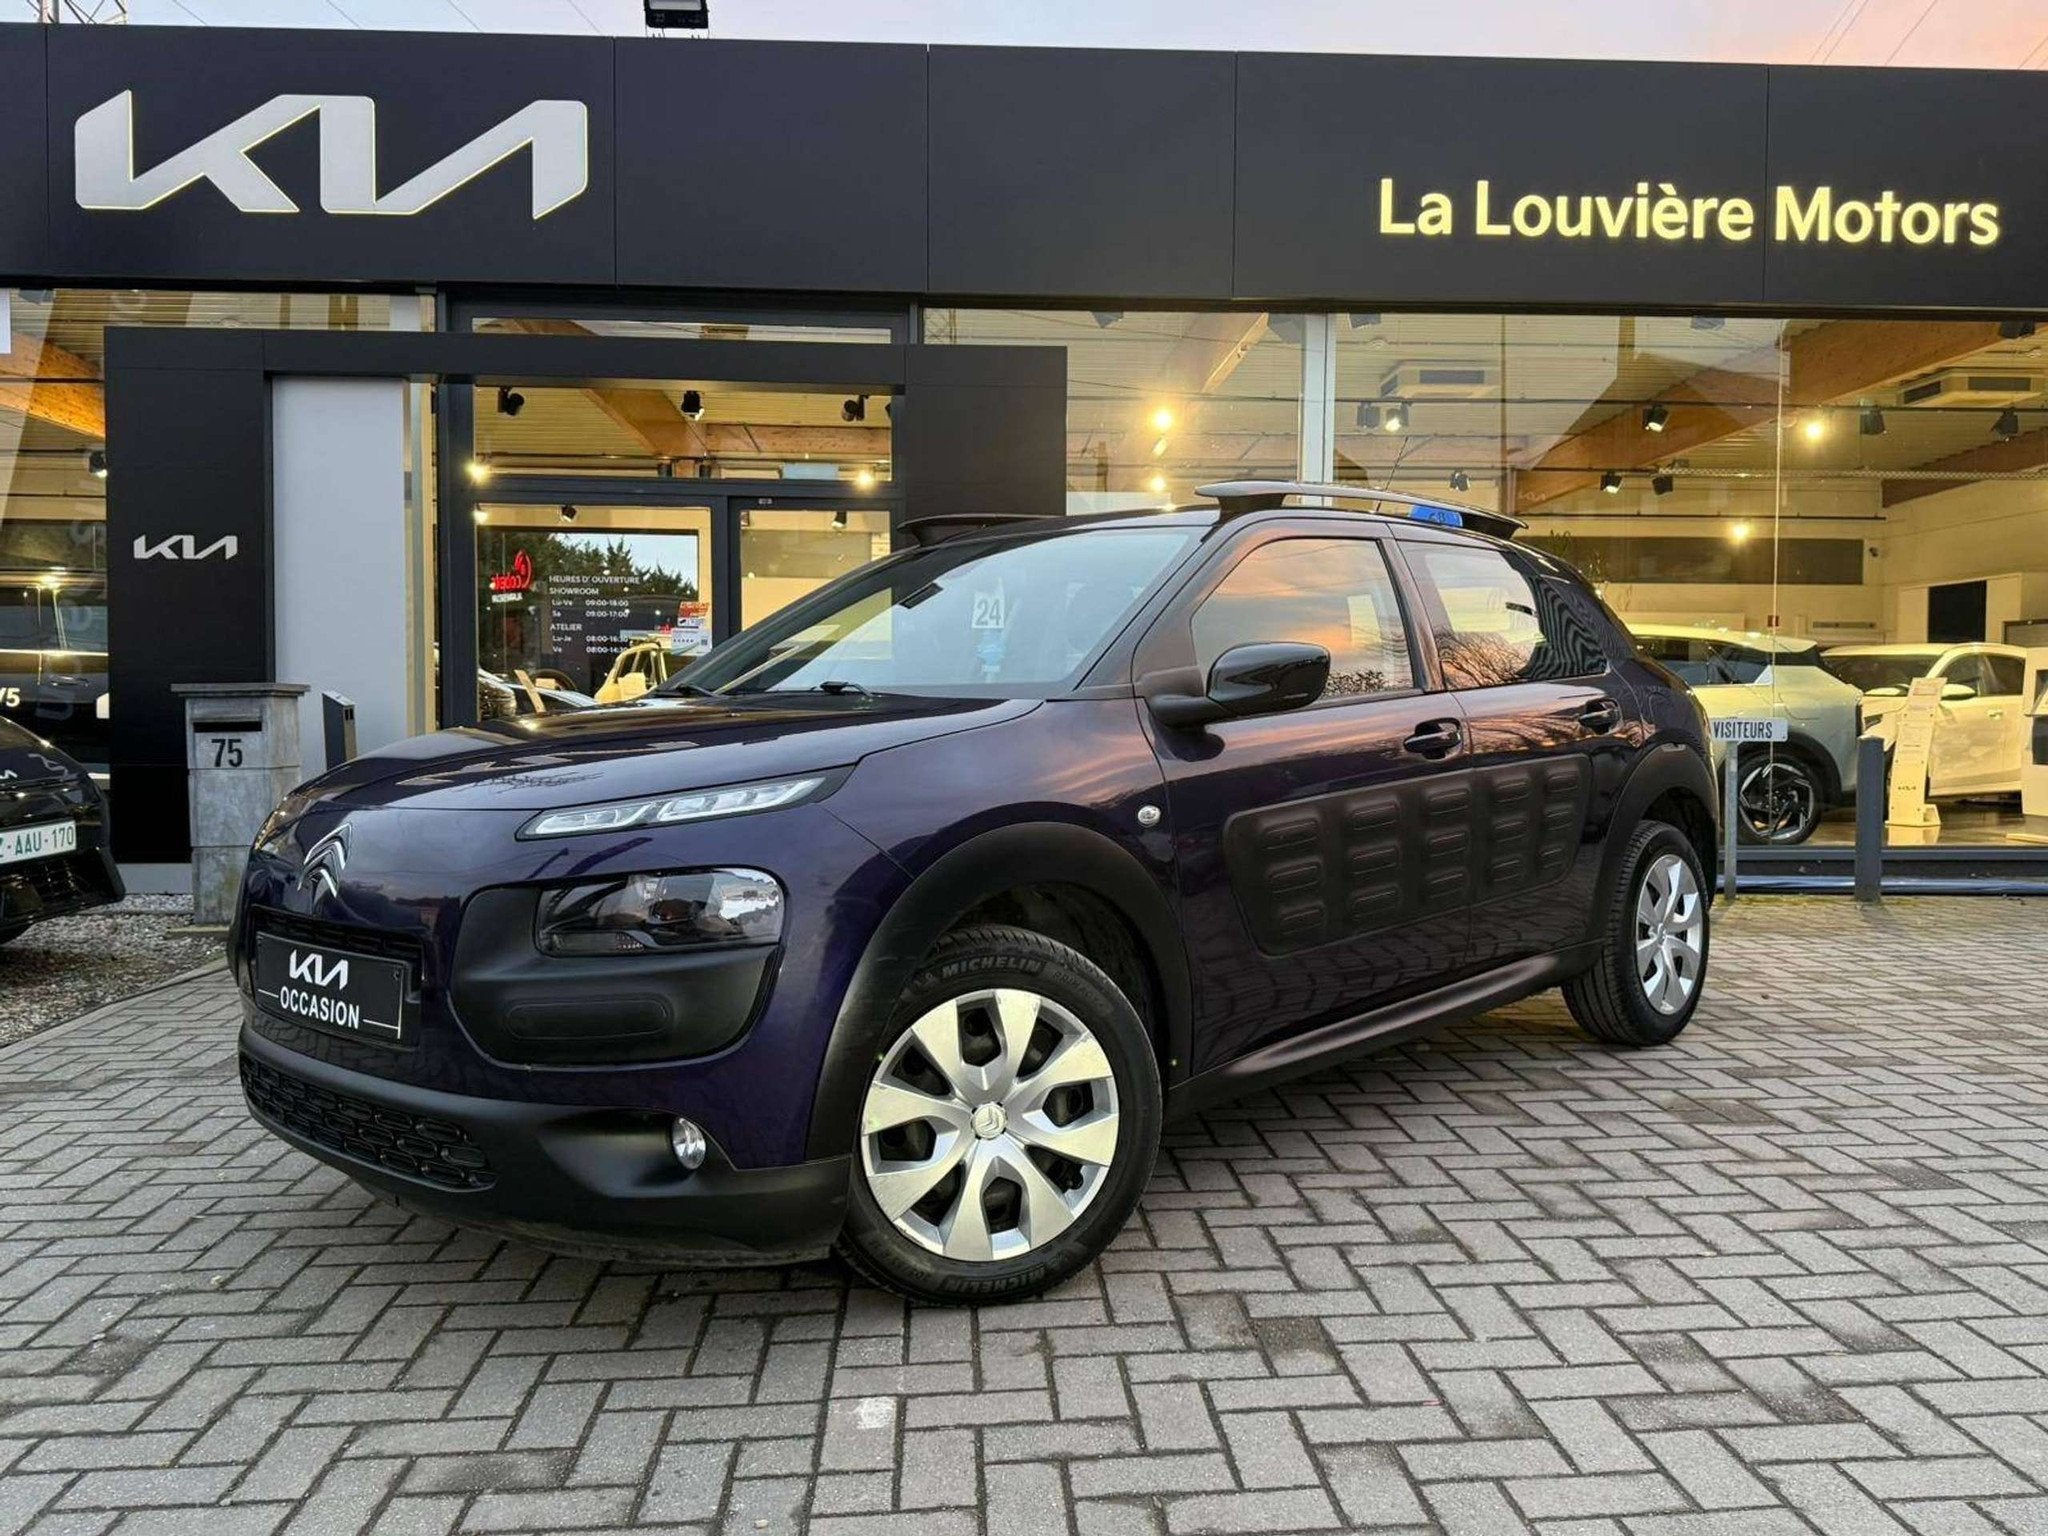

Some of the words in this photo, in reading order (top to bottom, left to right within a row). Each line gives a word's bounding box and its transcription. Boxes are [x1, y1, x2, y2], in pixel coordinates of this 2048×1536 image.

[75, 89, 588, 220] KIA
[1378, 177, 1454, 236] La
[1474, 180, 1756, 241] Louvière
[1774, 184, 2001, 246] Motors
[133, 534, 238, 561] KIA
[549, 575, 580, 584] HEURES
[591, 575, 640, 585] OUVERTURE
[549, 587, 600, 596] SHOWROOM
[975, 599, 1002, 626] 24
[550, 623, 583, 632] ATELIER
[1713, 721, 1773, 739] VISITEURS
[210, 738, 243, 768] 75
[288, 949, 349, 990] KIA
[941, 955, 1042, 978] MICHELIN
[280, 985, 360, 1030] OCCASION
